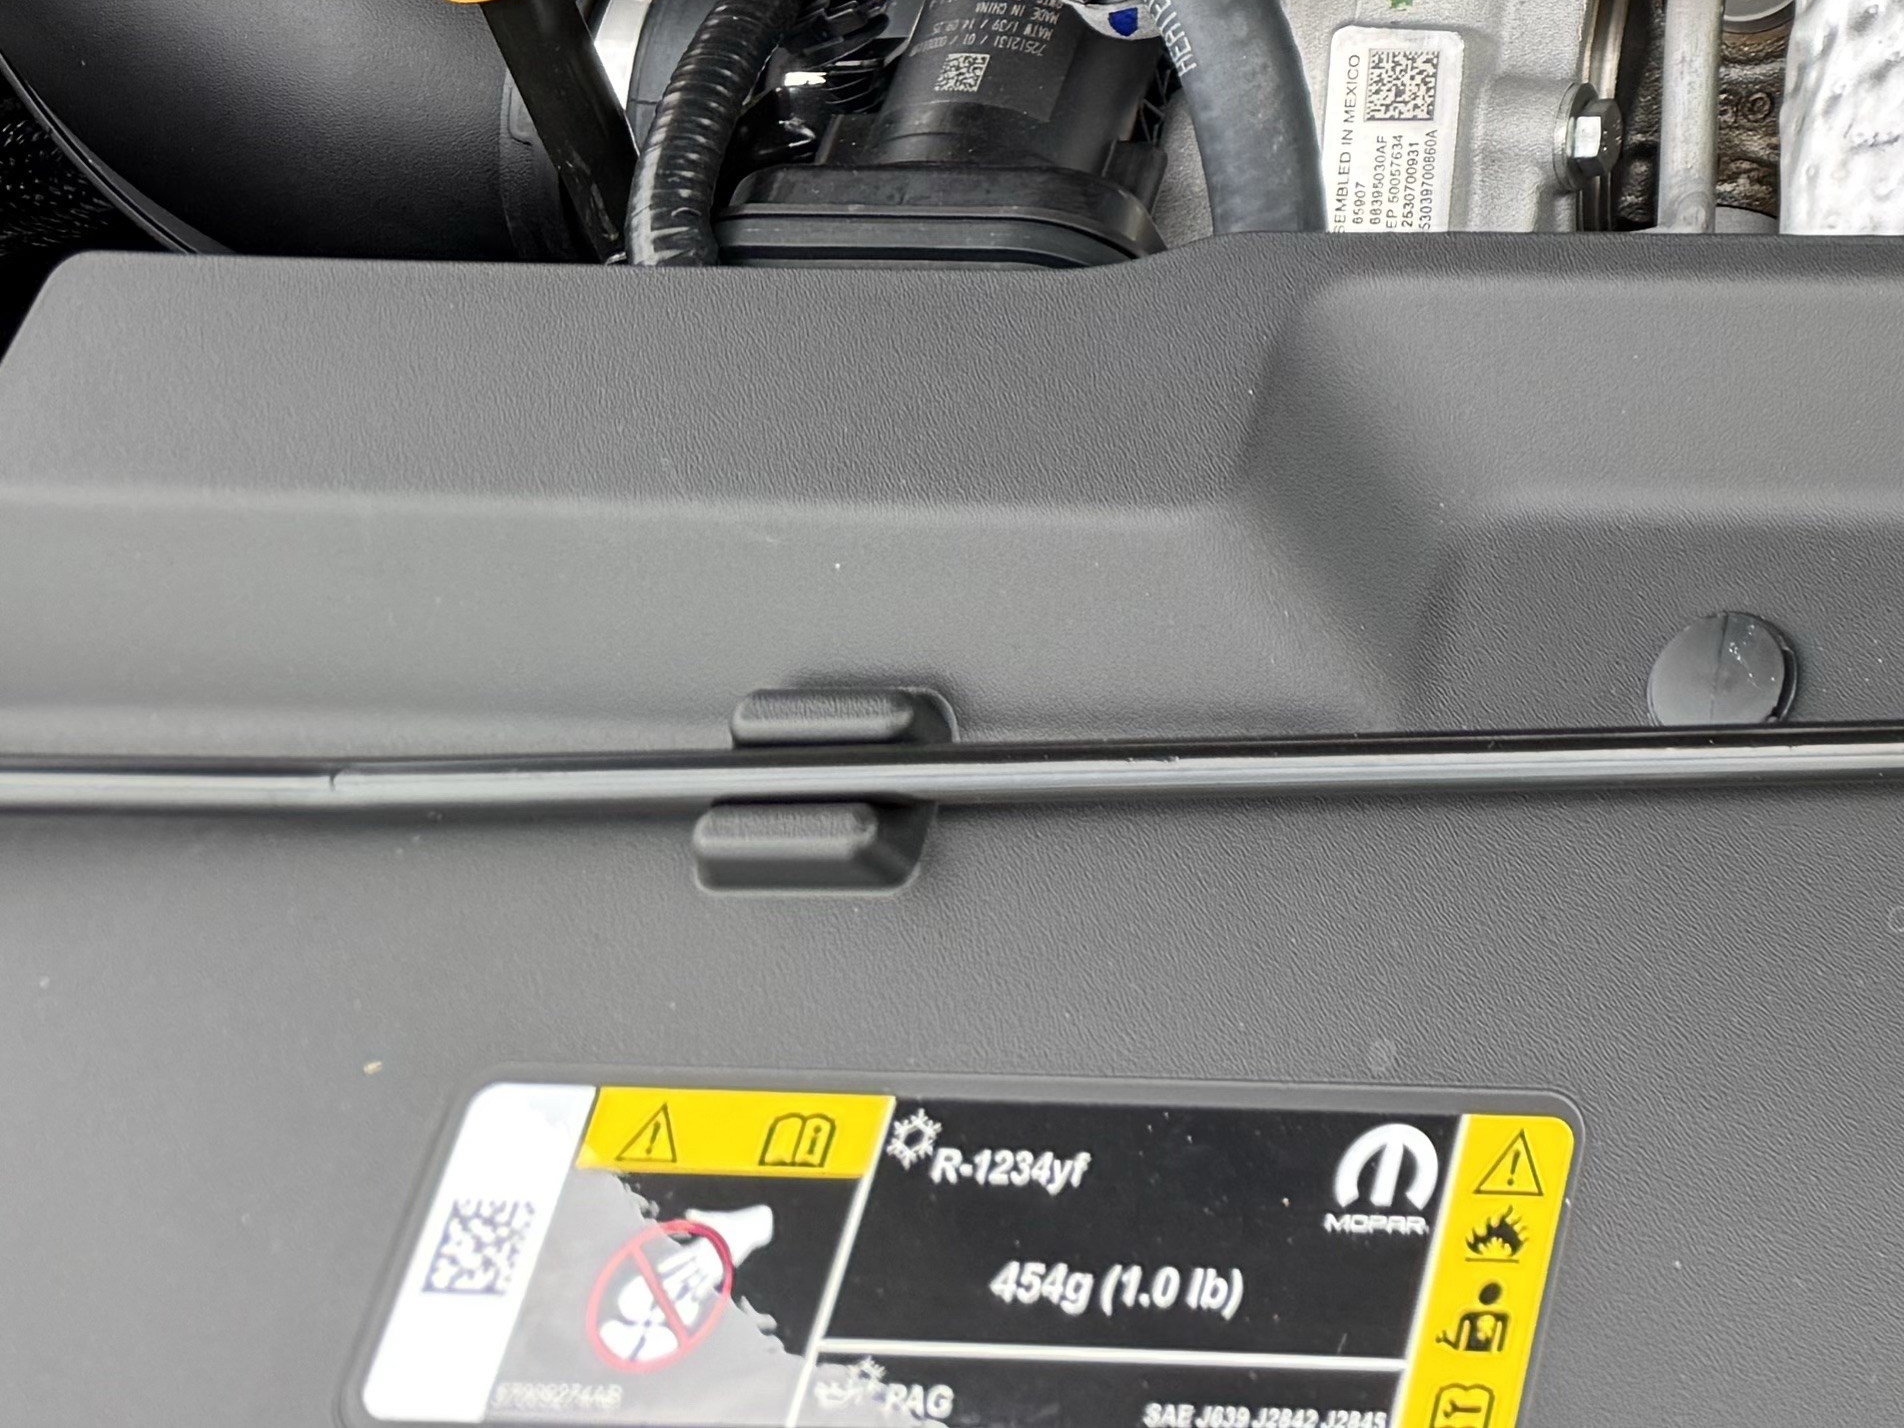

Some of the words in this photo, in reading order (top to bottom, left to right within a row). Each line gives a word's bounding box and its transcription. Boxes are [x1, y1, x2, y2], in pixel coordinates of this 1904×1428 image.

[974, 0, 1007, 15] CHINA
[1010, 4, 1025, 17] IN
[1031, 8, 1060, 23] MADE
[1343, 54, 1360, 123] MEXICO
[1341, 129, 1353, 145] IN
[930, 1148, 1091, 1190] R-1234yf
[989, 1265, 1093, 1312] 454g
[1101, 1264, 1178, 1312] (1.0
[1185, 1266, 1246, 1314] lb)
[881, 1382, 953, 1420] PAG
[1144, 1403, 1192, 1426] SAE
